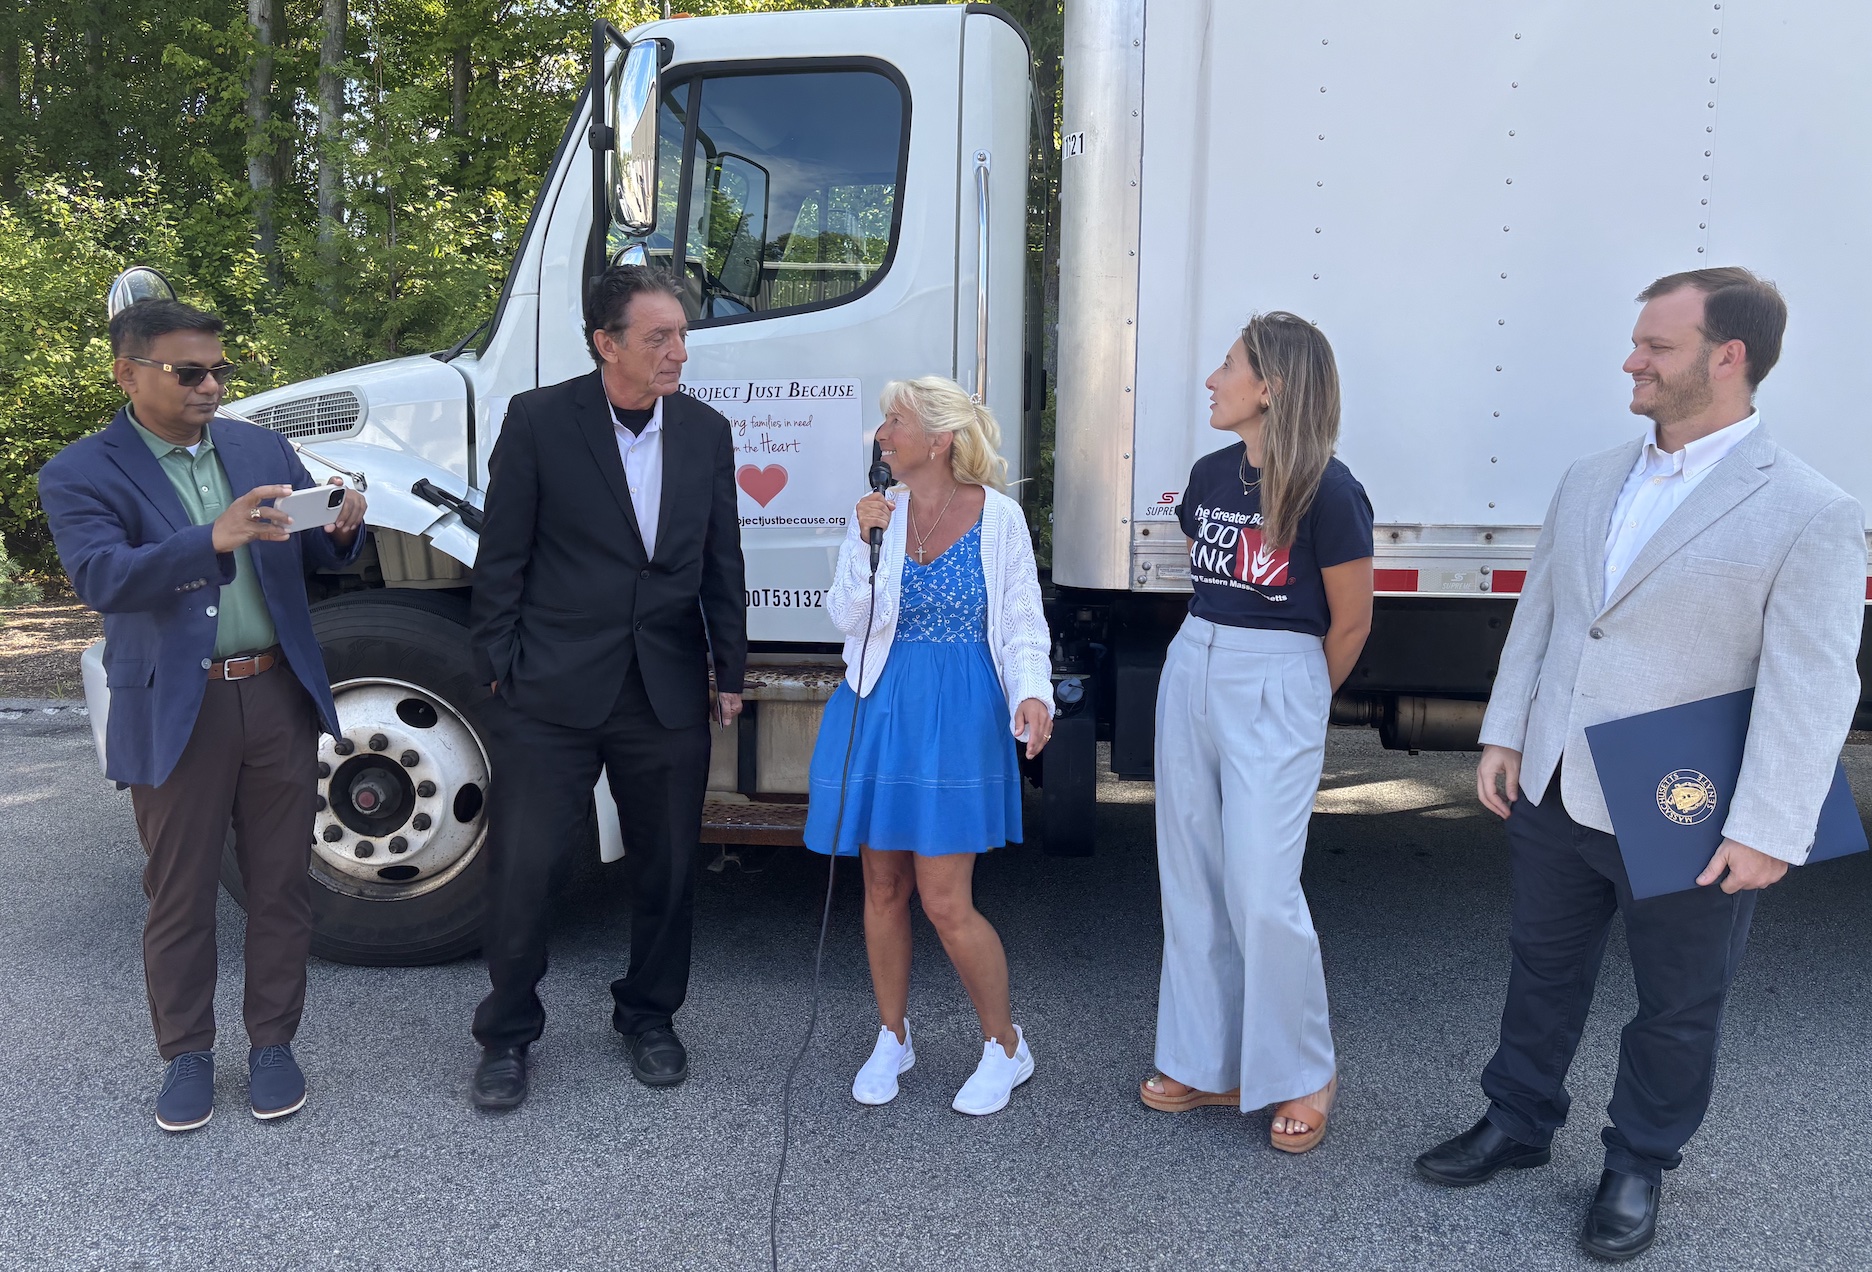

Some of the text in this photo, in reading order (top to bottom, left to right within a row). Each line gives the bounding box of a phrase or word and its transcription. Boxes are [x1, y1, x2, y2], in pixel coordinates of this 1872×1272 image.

[751, 415, 782, 429] families
[784, 417, 793, 427] in
[793, 415, 813, 427] need
[743, 432, 801, 453] the Heart
[1146, 506, 1177, 516] SUPRE
[1195, 504, 1210, 518] he
[1211, 507, 1252, 525] Greater
[737, 516, 846, 526] ojectjustbecause.org
[1190, 540, 1233, 578] ANK
[1199, 575, 1228, 586] Eastern
[1658, 772, 1715, 823] MASSACHUSETTS SENATE
